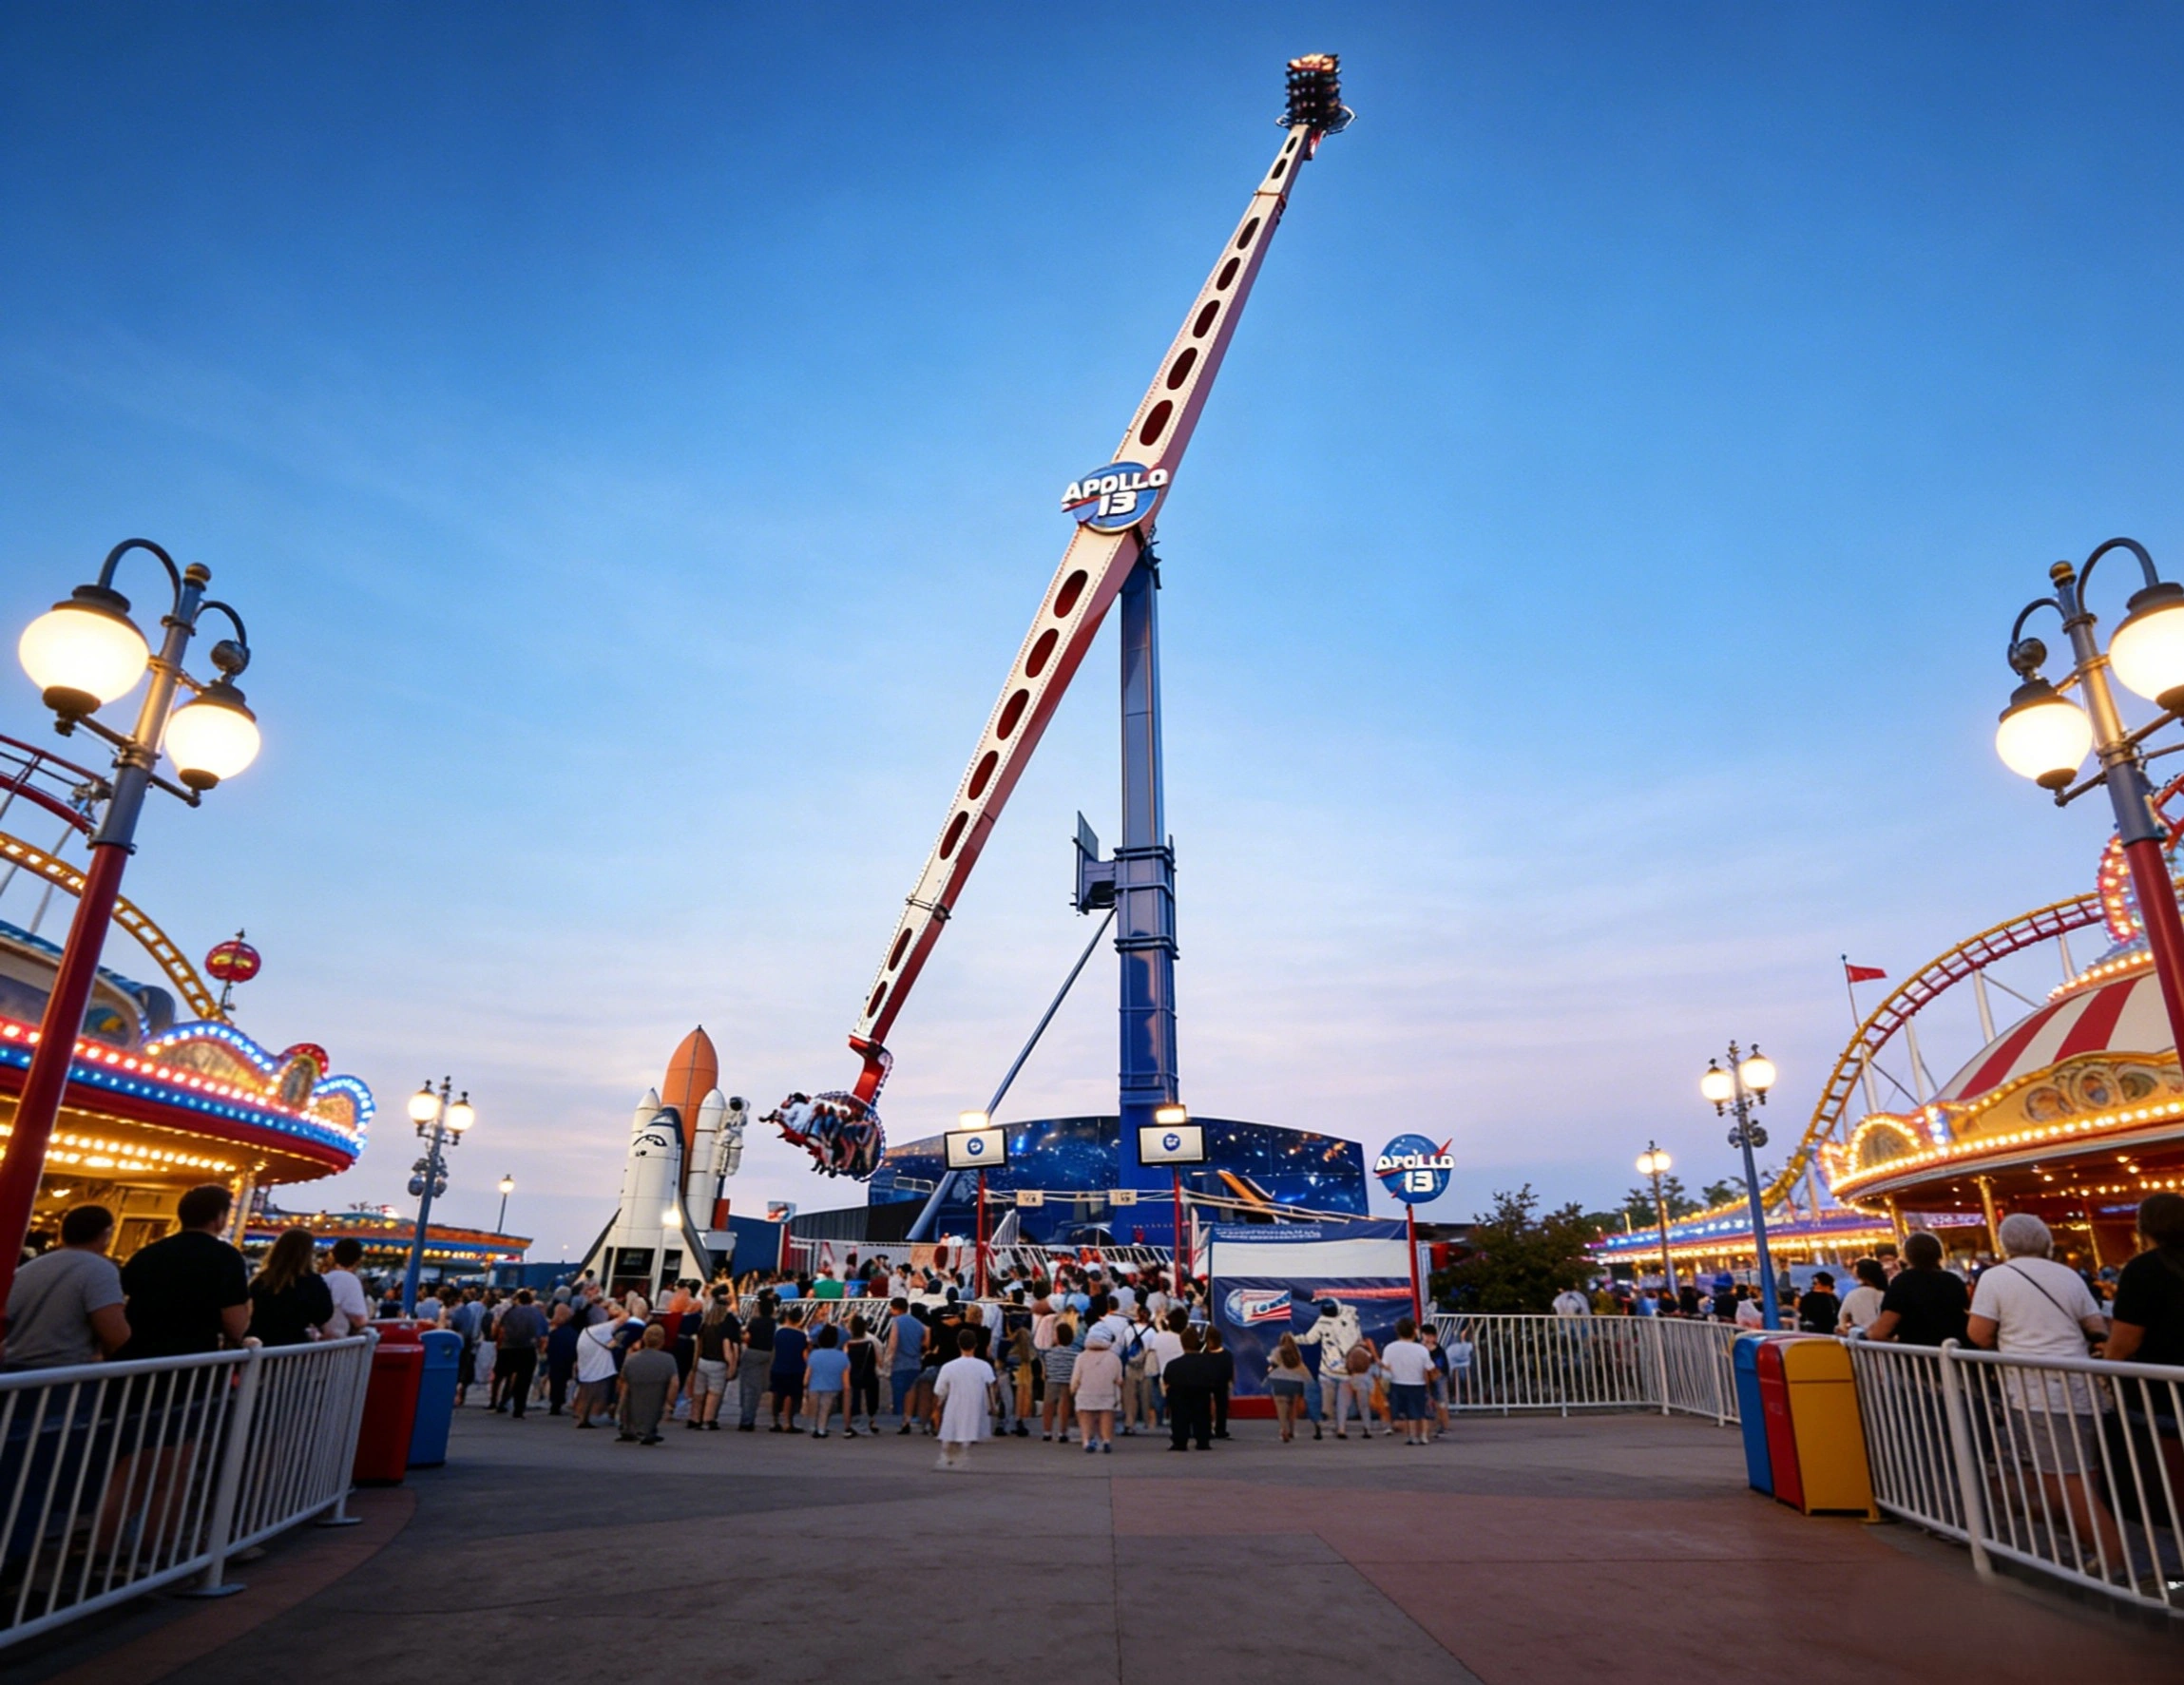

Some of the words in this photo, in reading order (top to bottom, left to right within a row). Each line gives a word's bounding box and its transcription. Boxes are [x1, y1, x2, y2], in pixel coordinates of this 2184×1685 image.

[1061, 469, 1168, 504] APOLLO
[1098, 490, 1137, 517] 13
[1374, 1154, 1455, 1171] APOLLO
[1405, 1170, 1434, 1194] 13
